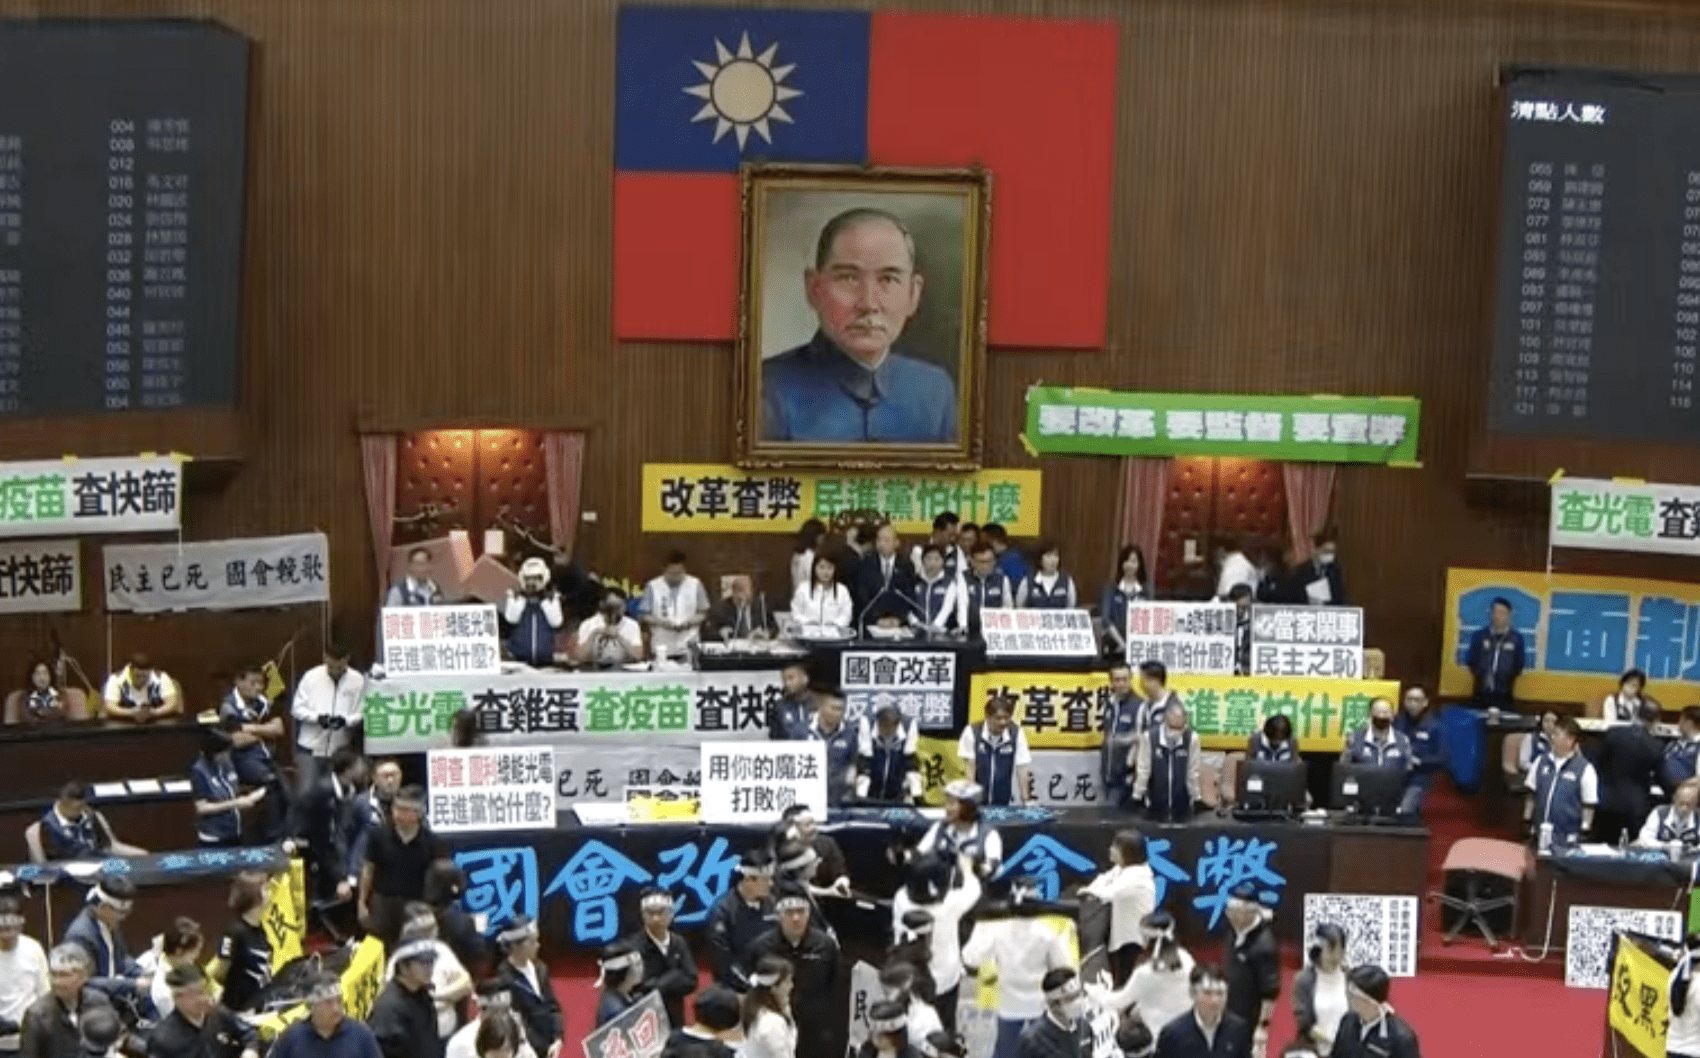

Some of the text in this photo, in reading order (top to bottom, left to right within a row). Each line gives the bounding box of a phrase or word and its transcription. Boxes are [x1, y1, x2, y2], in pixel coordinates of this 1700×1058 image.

[110, 120, 135, 133] 004
[109, 157, 134, 170] 012
[108, 194, 133, 208] 020
[107, 287, 132, 301] 040
[73, 469, 176, 518] 查快篩
[661, 477, 1021, 523] 改革查弊 民進黨怕什麼
[1557, 490, 1700, 540] 查光電 查
[109, 563, 209, 594] 民主已死
[388, 643, 496, 672] 民進黨怕什麼?
[844, 655, 952, 686] 國會改革
[1255, 645, 1357, 677] 民主之恥
[472, 687, 580, 734] 查雞蛋
[584, 684, 691, 732] 查疫苗
[709, 754, 818, 782] 用你的魔法
[432, 790, 552, 826] 民進黨怕什麼?
[731, 786, 797, 814] 打敗你
